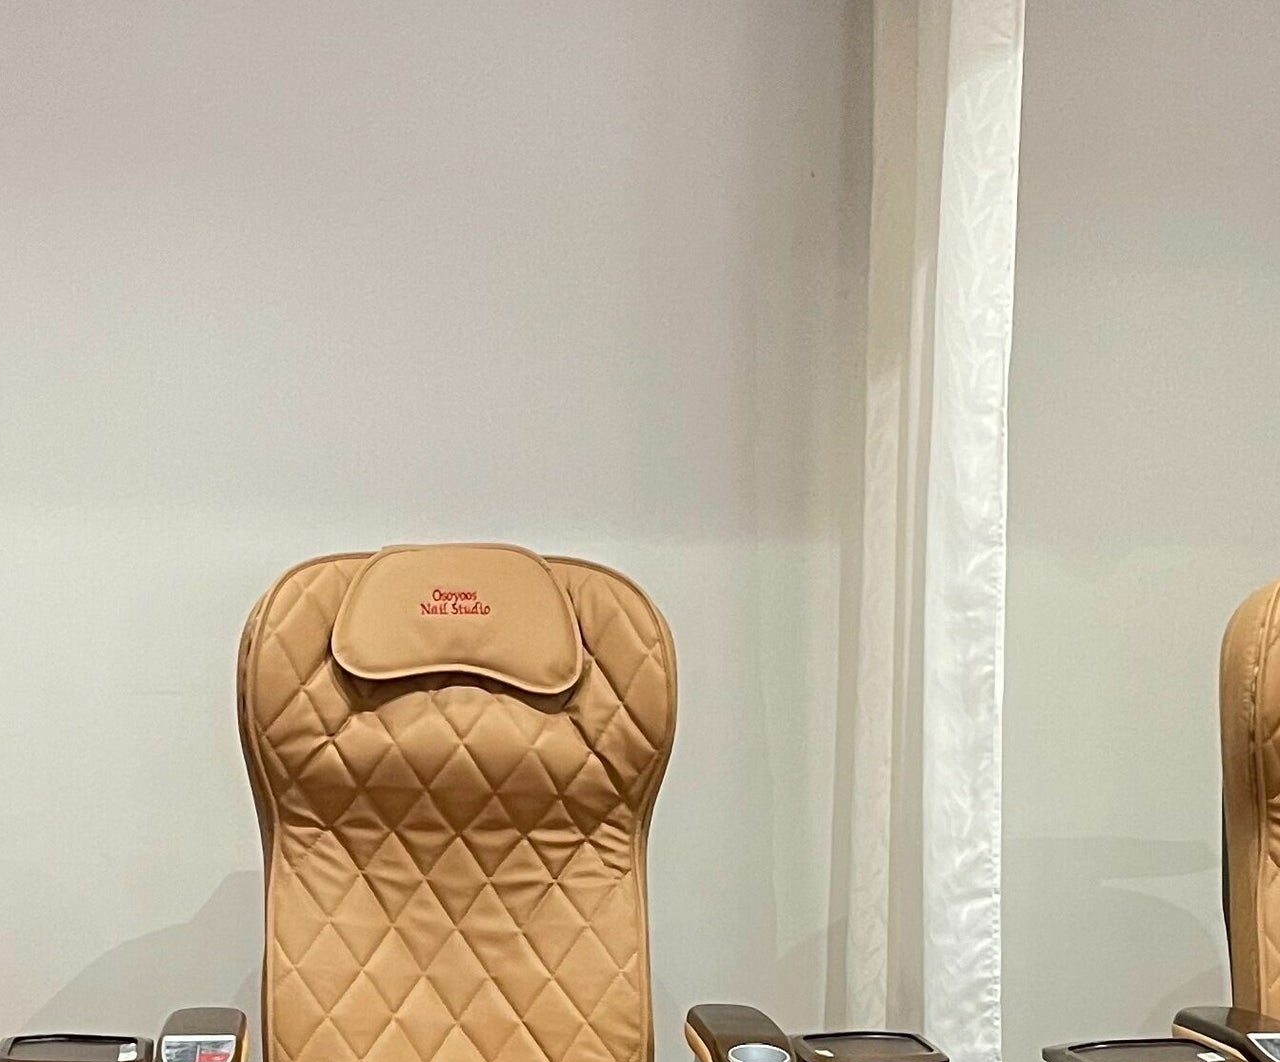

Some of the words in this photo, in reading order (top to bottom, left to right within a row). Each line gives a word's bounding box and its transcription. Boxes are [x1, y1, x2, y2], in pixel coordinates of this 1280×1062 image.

[432, 589, 477, 603] Osoyoos
[420, 603, 448, 615] Nail
[451, 602, 491, 615] Studio
